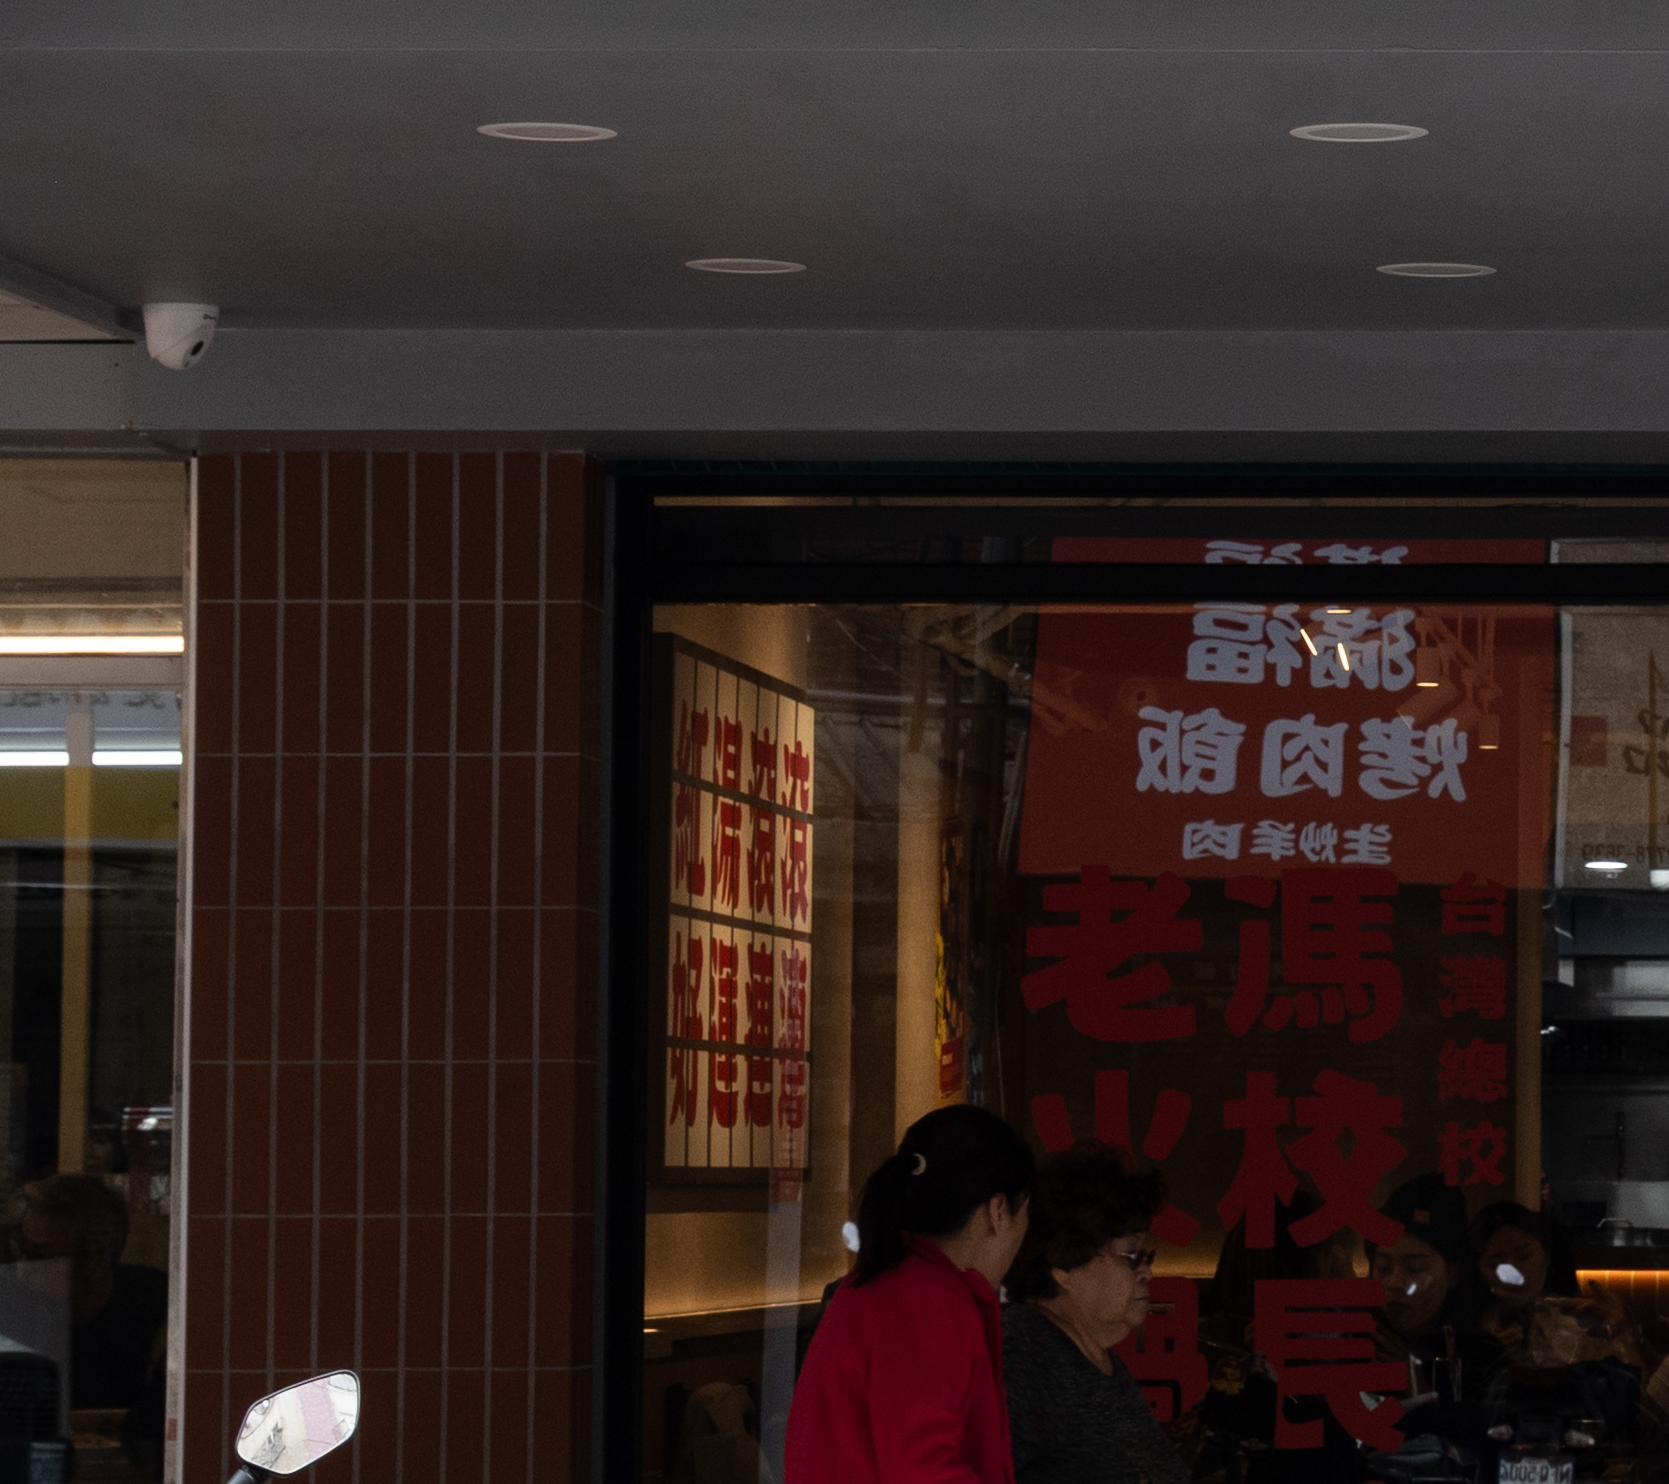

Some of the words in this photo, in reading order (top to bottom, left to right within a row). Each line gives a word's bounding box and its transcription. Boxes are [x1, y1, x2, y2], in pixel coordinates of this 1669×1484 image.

[1217, 868, 1407, 1452] 馮校長
[1438, 872, 1509, 1188] 台灣總校
